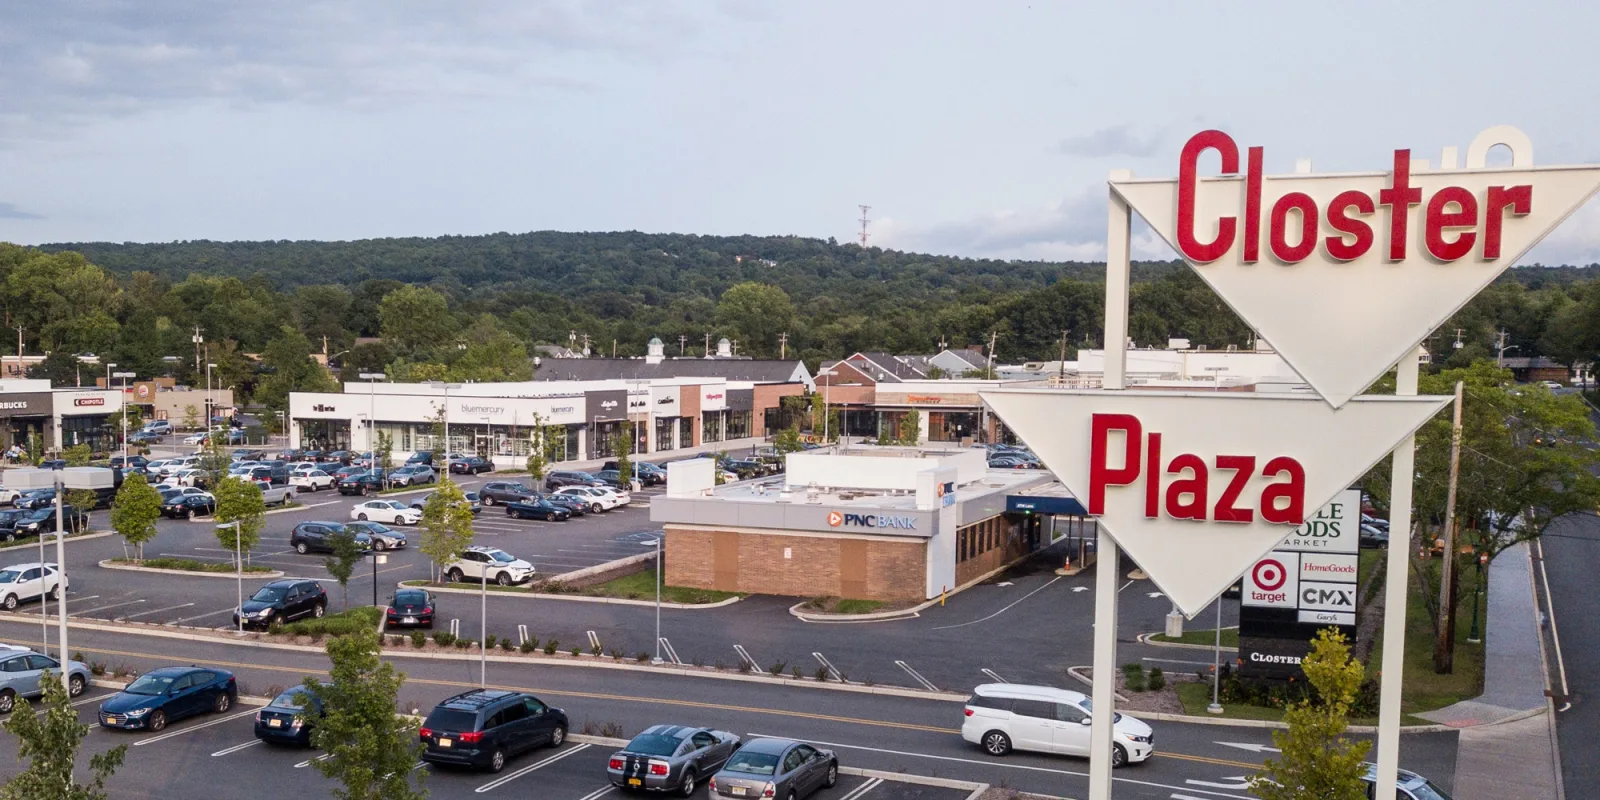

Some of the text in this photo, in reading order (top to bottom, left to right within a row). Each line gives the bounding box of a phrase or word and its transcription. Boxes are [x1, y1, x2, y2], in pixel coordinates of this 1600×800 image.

[1177, 129, 1533, 263] Closter
[461, 404, 505, 414] bluemercury
[1088, 413, 1306, 526] Plaza
[844, 513, 917, 530] PNC BANK
[1304, 563, 1355, 573] HomeGoods
[1252, 591, 1286, 603] target
[1302, 588, 1353, 606] CMX
[1317, 613, 1337, 621] Gary's
